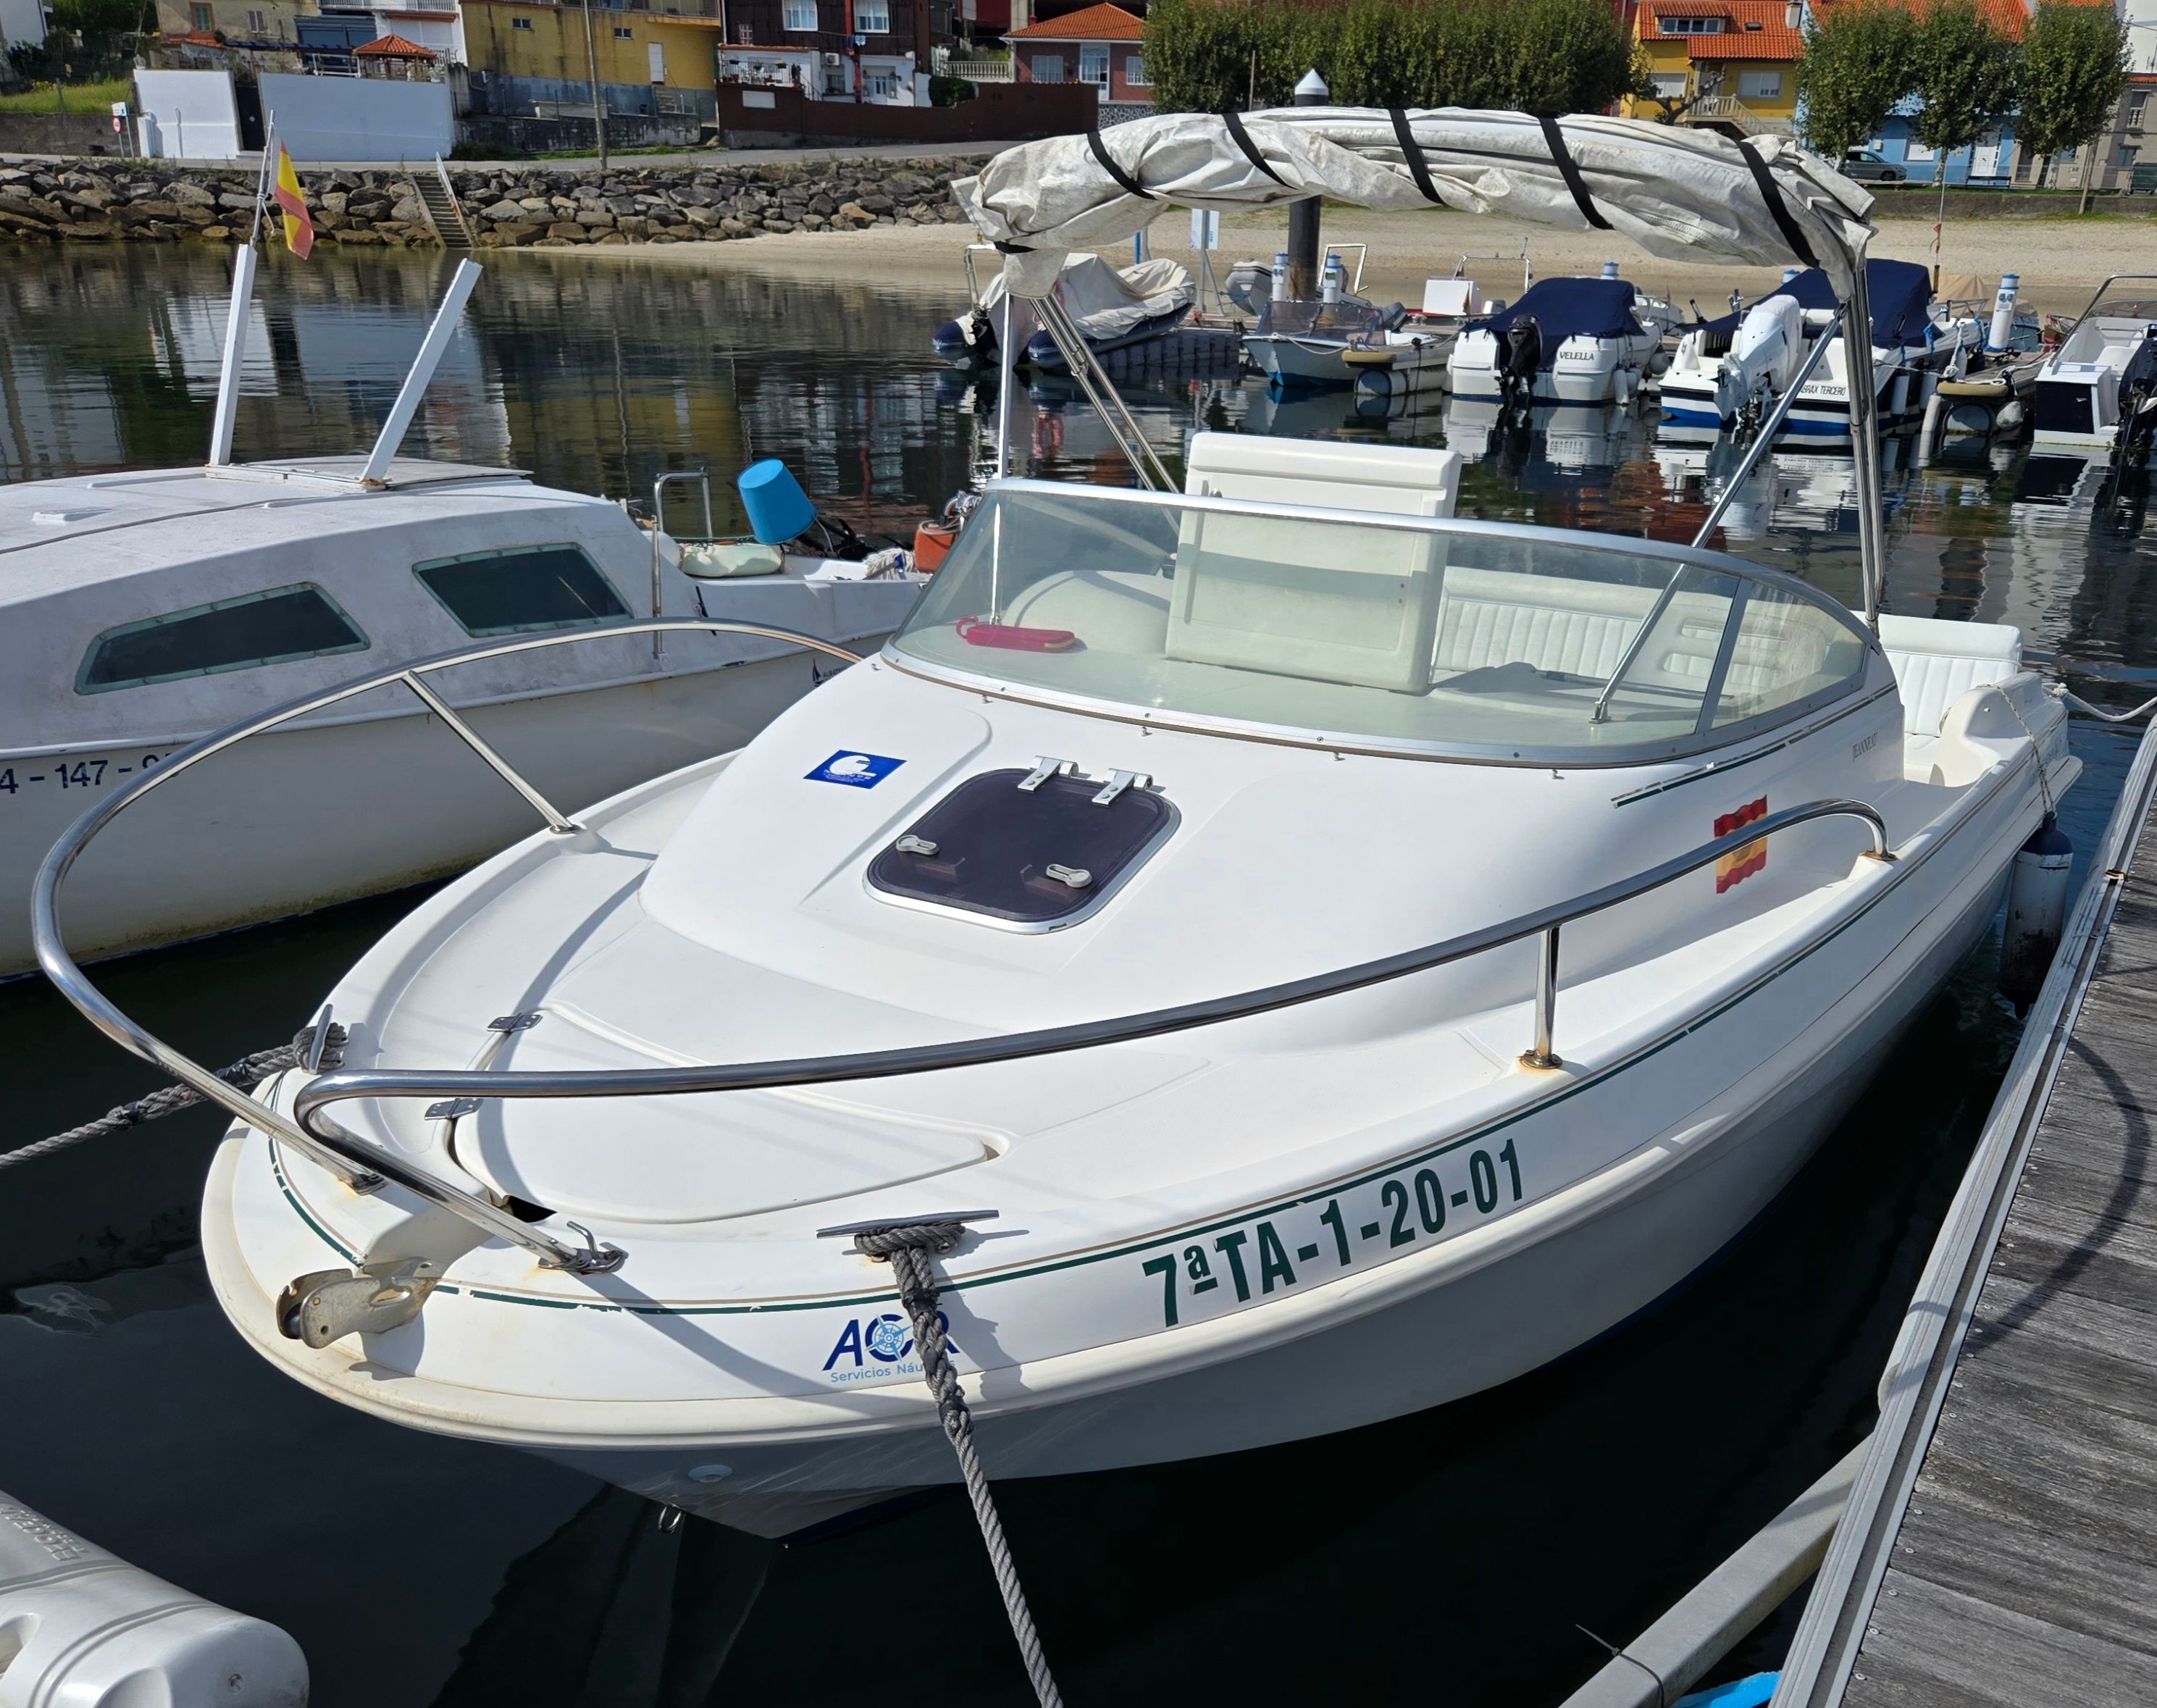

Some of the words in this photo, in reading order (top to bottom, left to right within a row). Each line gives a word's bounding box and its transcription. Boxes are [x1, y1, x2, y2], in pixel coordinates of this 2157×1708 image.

[1559, 351, 1594, 361] VELELLA
[1852, 732, 1877, 764] JEANNEAU
[831, 1366, 891, 1383] Servicios
